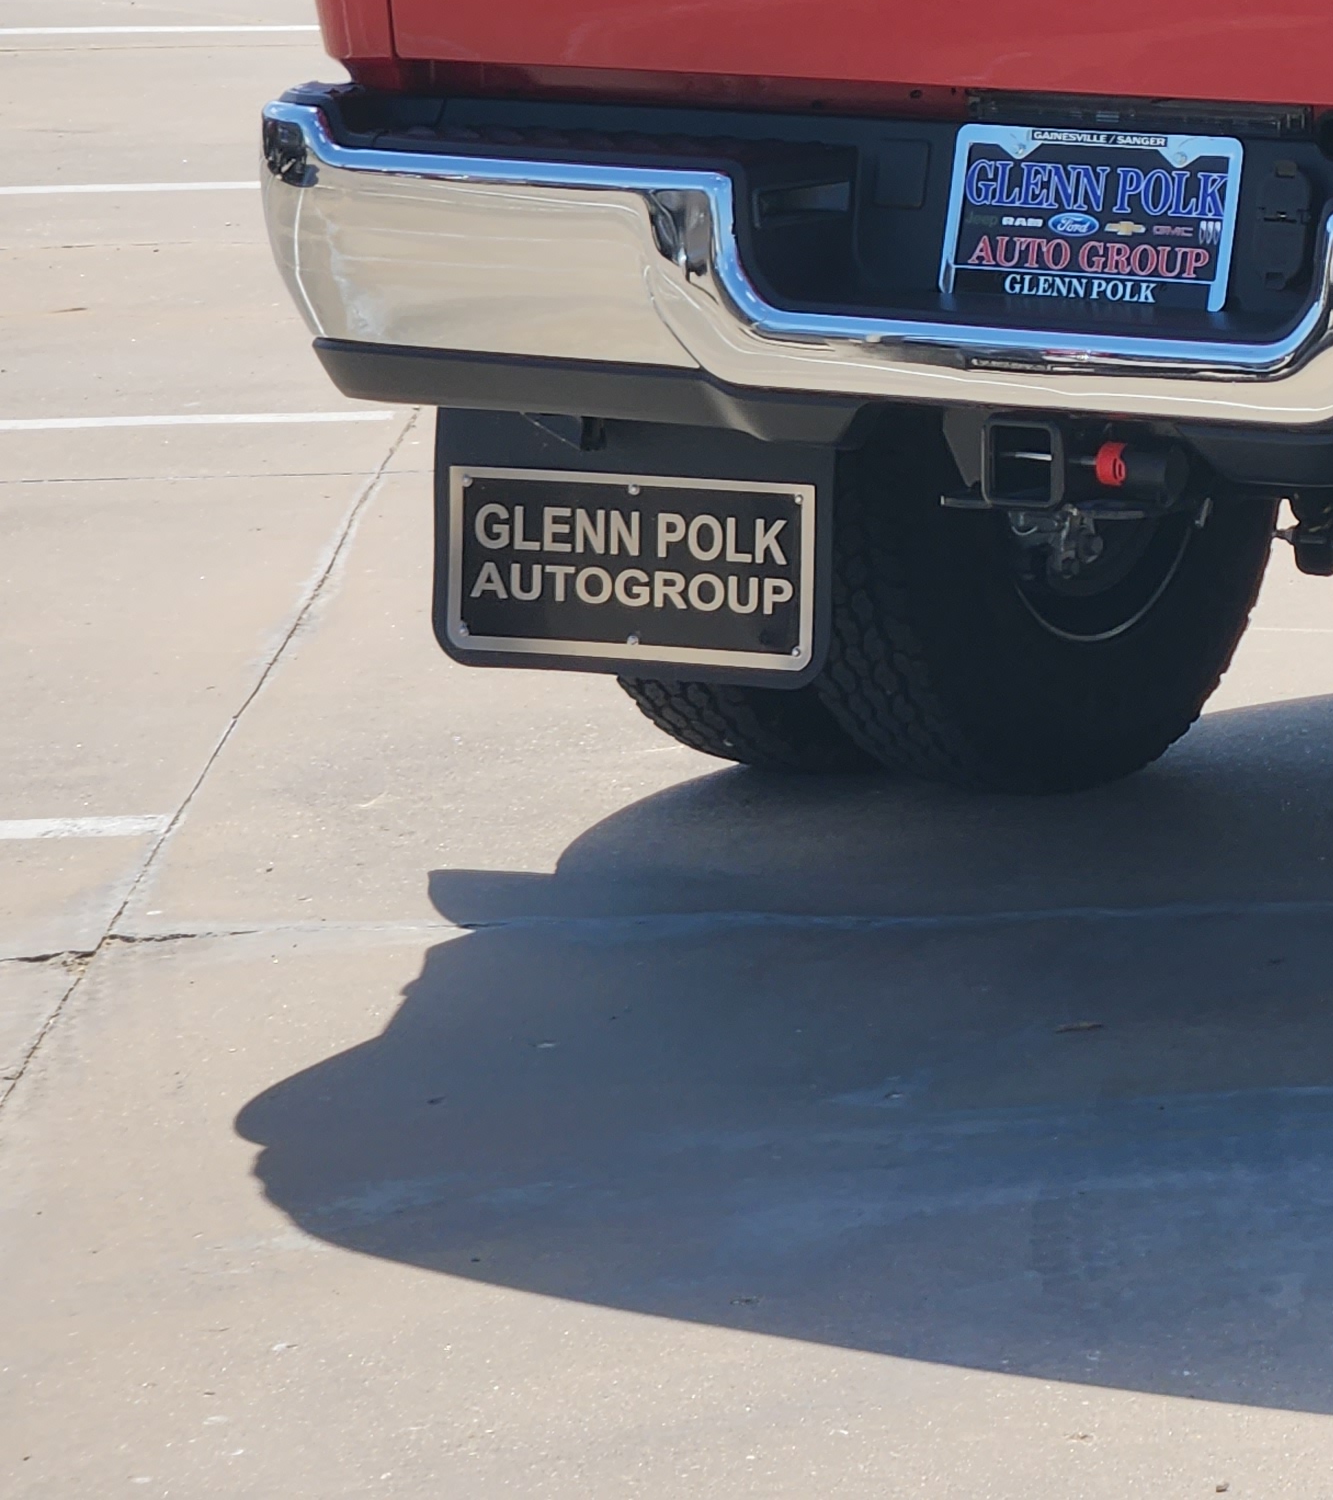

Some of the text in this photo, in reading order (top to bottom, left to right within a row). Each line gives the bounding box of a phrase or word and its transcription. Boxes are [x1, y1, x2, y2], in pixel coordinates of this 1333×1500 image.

[1034, 131, 1107, 143] GAINESVILLE
[1117, 135, 1166, 146] SANGER
[966, 159, 1228, 218] GLENN POLK
[1002, 217, 1043, 228] RAM
[1153, 225, 1193, 237] GMC
[968, 235, 1209, 278] AUTO GROUP
[1004, 273, 1157, 302] GLENN POLK
[474, 502, 788, 566] GLENN POLK
[470, 561, 794, 615] AUTOGROUP
